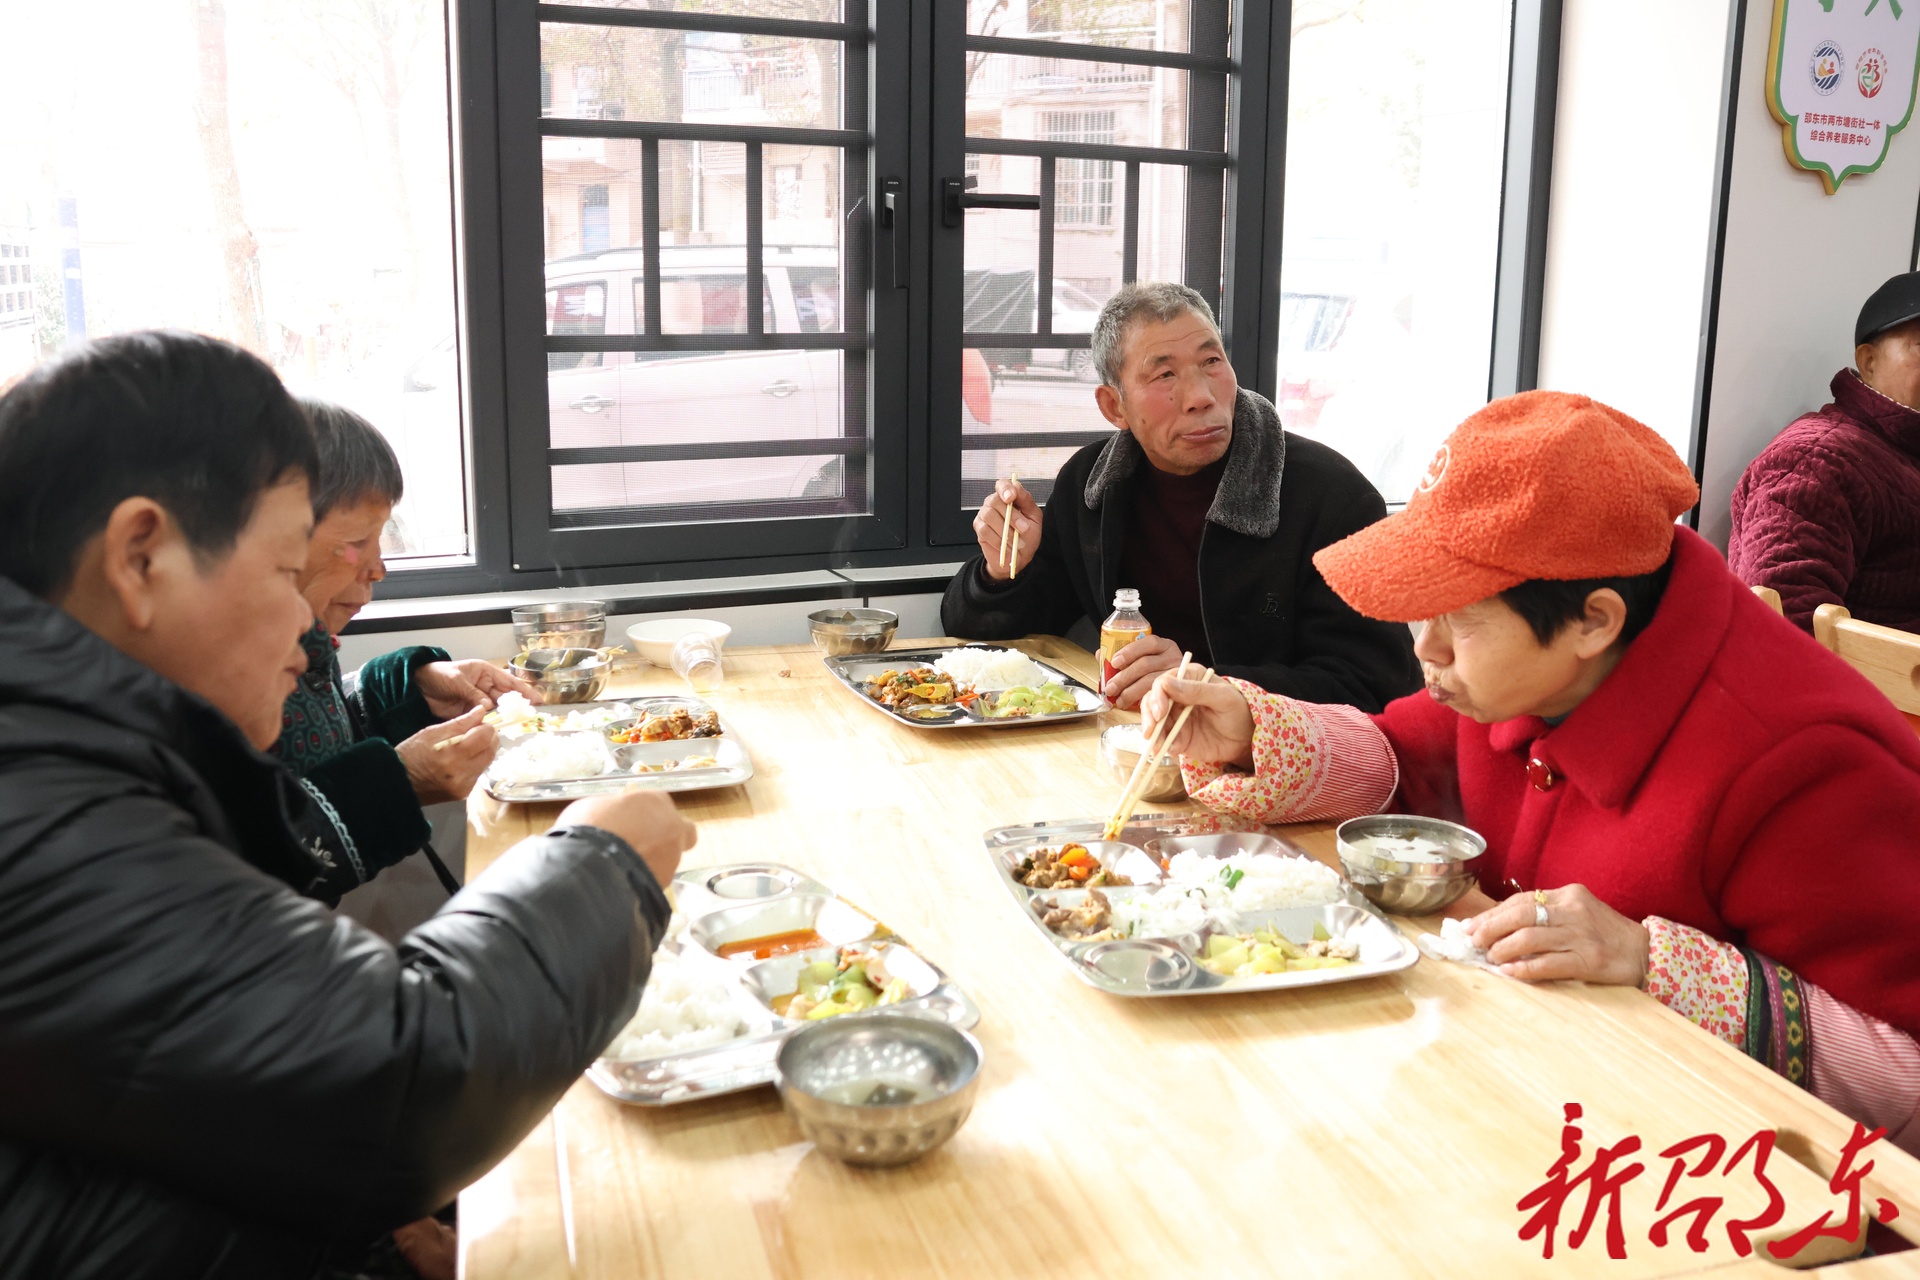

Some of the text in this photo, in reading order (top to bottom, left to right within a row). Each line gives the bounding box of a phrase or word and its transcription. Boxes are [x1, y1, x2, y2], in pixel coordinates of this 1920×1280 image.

[1804, 112, 1881, 130] 邵东市两市塘街社一体
[1810, 130, 1871, 146] 综合养老服务中心
